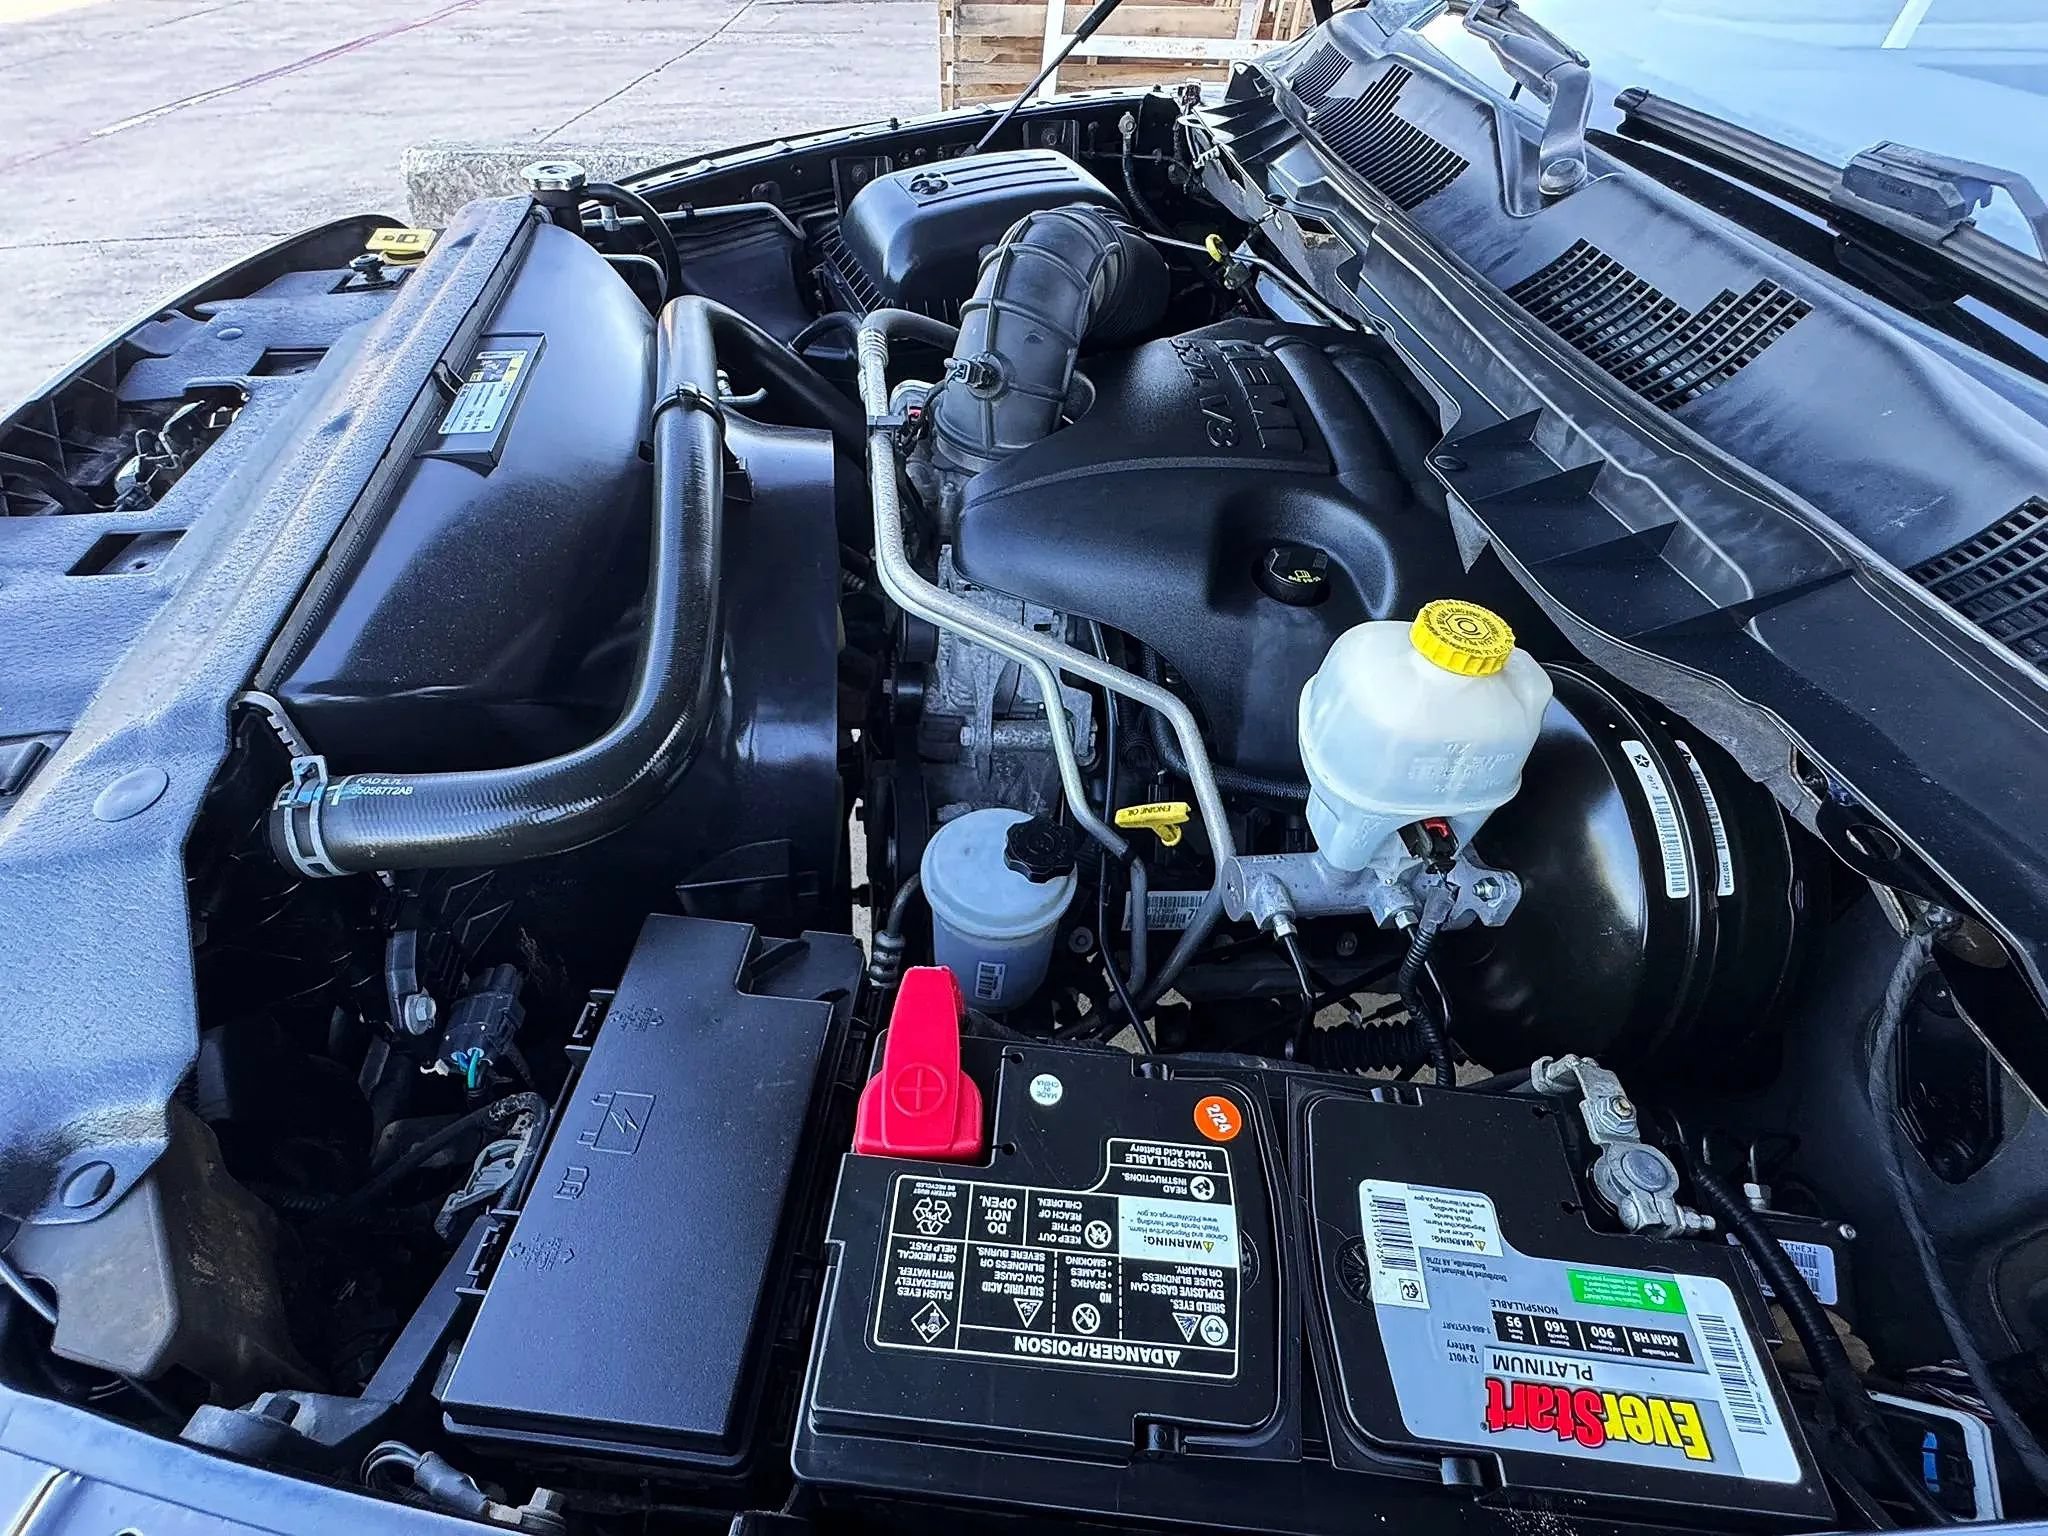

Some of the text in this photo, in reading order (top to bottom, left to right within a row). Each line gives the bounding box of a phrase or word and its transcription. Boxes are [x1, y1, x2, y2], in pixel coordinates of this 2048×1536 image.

[1199, 393, 1241, 447] V8
[1140, 805, 1171, 815] ENGINE
[1037, 1080, 1059, 1088] CHINA
[1037, 1091, 1057, 1099] MADE
[1129, 1144, 1206, 1159] Lead Acid Battery
[1125, 1153, 1212, 1170] NON-SPILLABLE
[1122, 1172, 1187, 1185] INSTRUCTIONS.
[913, 1187, 957, 1197] BATTERY MUST
[916, 1182, 947, 1190] RECYCLED
[1163, 1185, 1188, 1194] READ
[979, 1195, 1017, 1207] OPEN.
[1037, 1197, 1082, 1209] CHILDREN.
[985, 1209, 1012, 1221] NOT
[1038, 1209, 1082, 1220] REACH OF
[1455, 1215, 1472, 1223] Wash
[987, 1222, 1007, 1235] DO
[1165, 1220, 1179, 1228] after
[1180, 1221, 1200, 1230] hands
[1202, 1224, 1220, 1232] Wash
[1443, 1220, 1486, 1232] Reproductive
[1148, 1226, 1190, 1238] Reproductive
[1191, 1231, 1203, 1239] and
[1205, 1233, 1229, 1242] Cancer
[1452, 1230, 1474, 1238] Cancer
[1038, 1232, 1081, 1245] KEEP OUT
[1143, 1235, 1203, 1250] WARNING:
[1431, 1235, 1475, 1248] WARNING:
[908, 1241, 957, 1253] HELP FAST.
[897, 1249, 956, 1263] GET MEDICAL
[976, 1247, 1046, 1262] SEVERE BURNS.
[980, 1258, 1045, 1273] BLINDNESS OR
[1065, 1255, 1106, 1267] SMOKING
[898, 1266, 955, 1280] WITH WATER.
[994, 1270, 1045, 1284] CAN CAUSE
[1070, 1267, 1106, 1278] FLAMES
[1174, 1265, 1223, 1278] OR INJURY.
[1441, 1268, 1465, 1277] Walmart
[1472, 1270, 1507, 1282] Distributed
[895, 1276, 954, 1289] IMMEDIATELY
[1070, 1279, 1106, 1290] SPARKS
[1142, 1272, 1224, 1287] CAUSE BLINDNESS
[897, 1286, 953, 1300] FLUSH EYES
[982, 1281, 1044, 1297] SULFURIC ACID
[1130, 1282, 1224, 1300] EXPLOSIVE GASES CAN
[1099, 1292, 1112, 1303] NO
[1170, 1299, 1225, 1314] SHIELD EYES.
[1490, 1299, 1558, 1315] NONSPILLABLE
[1505, 1315, 1522, 1327] 95
[1544, 1320, 1567, 1333] 160
[1590, 1325, 1615, 1339] 900
[1632, 1331, 1678, 1347] AGM H8
[1014, 1336, 1164, 1364] DANGER/POISON
[1447, 1339, 1476, 1353] Battery
[1492, 1354, 1593, 1381] PLATINUM
